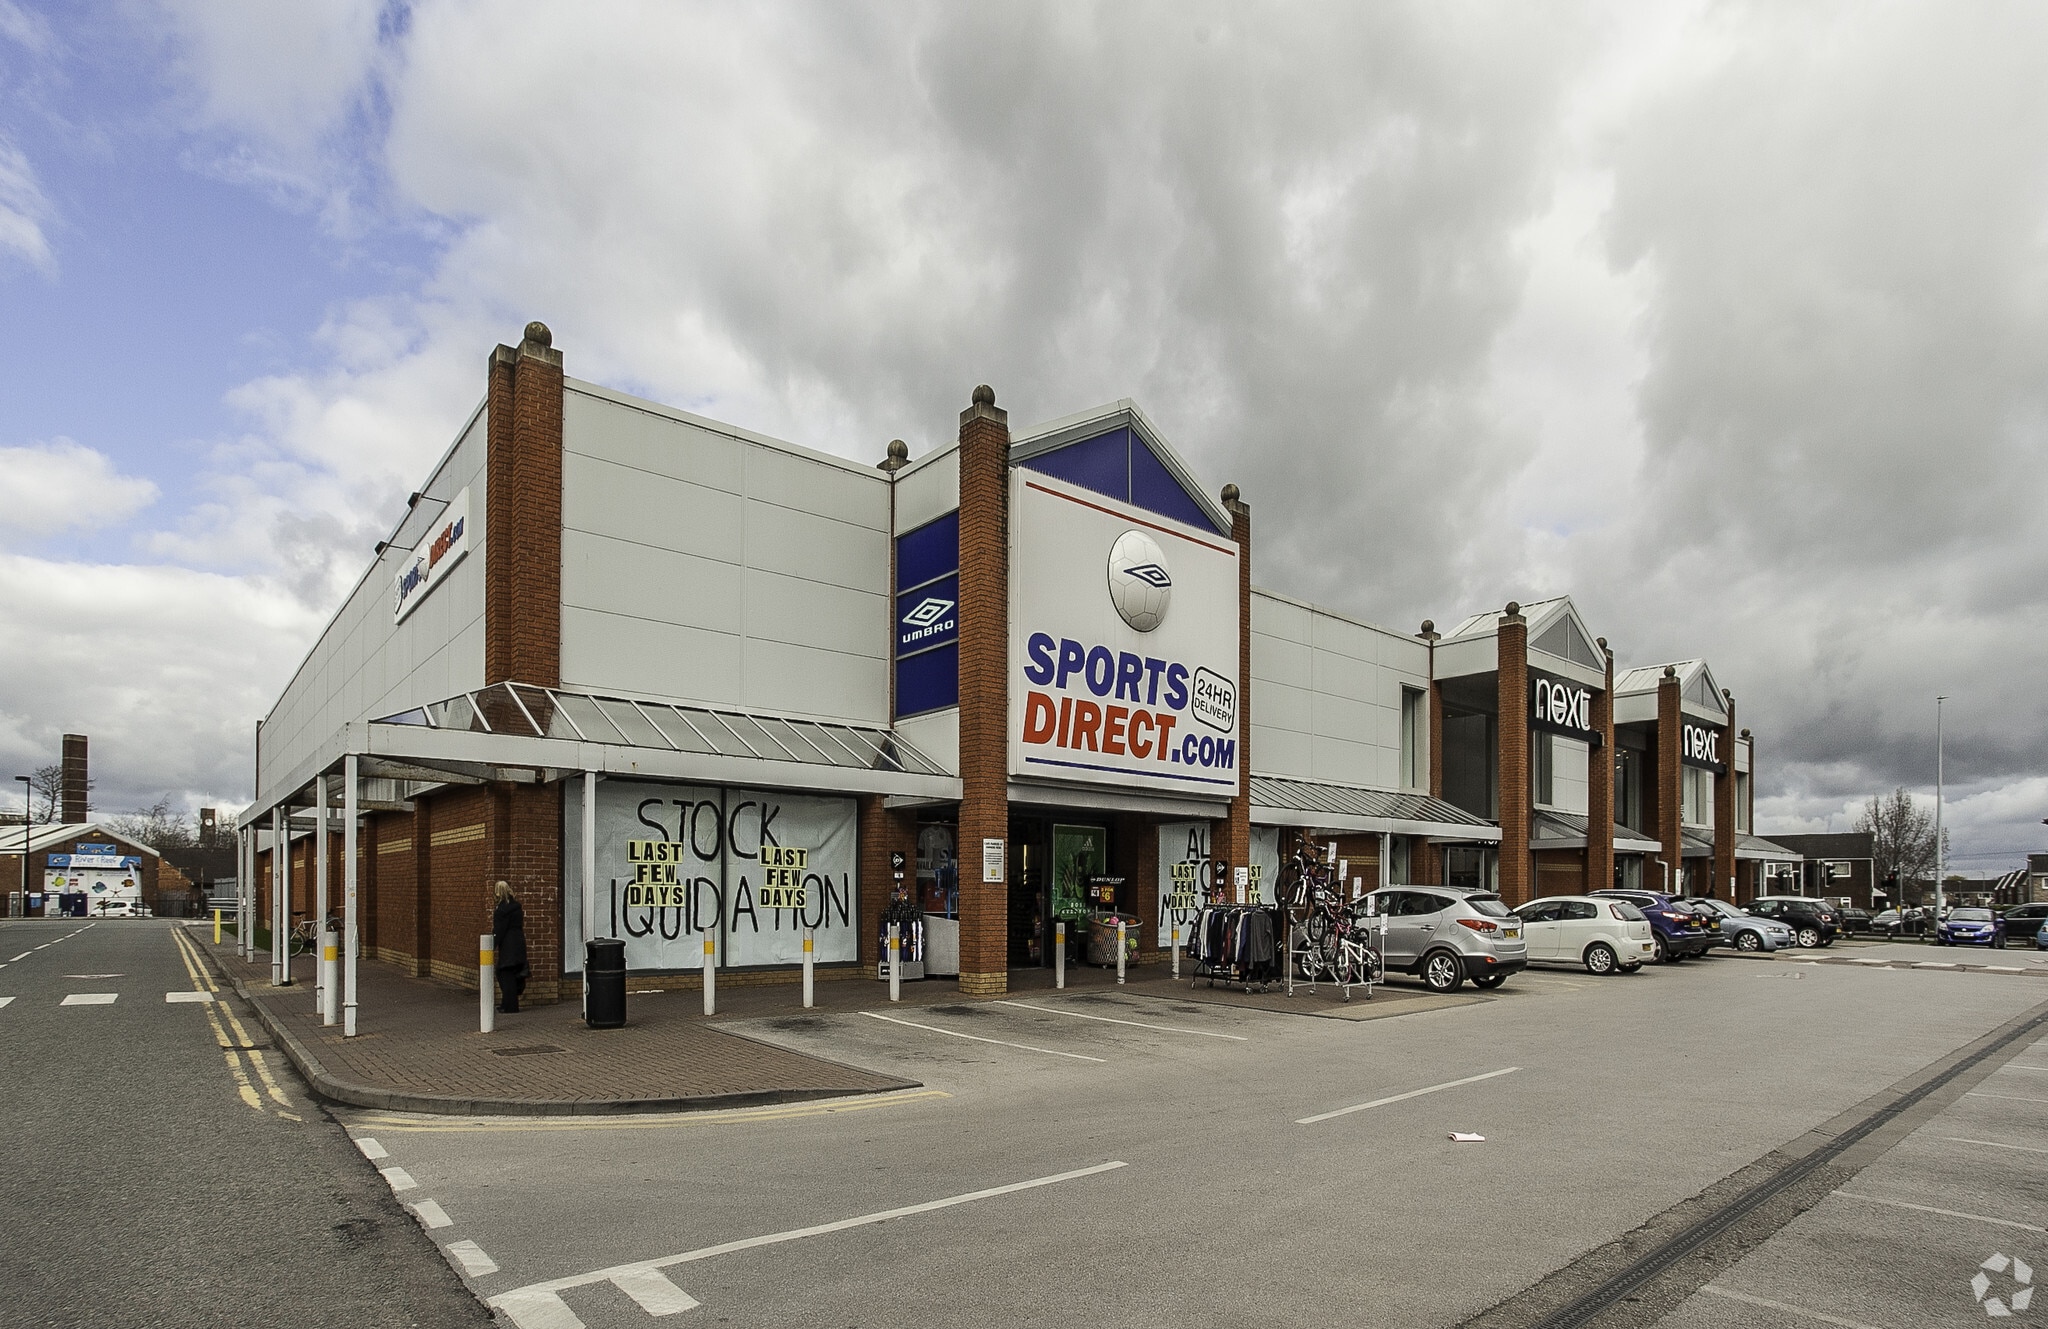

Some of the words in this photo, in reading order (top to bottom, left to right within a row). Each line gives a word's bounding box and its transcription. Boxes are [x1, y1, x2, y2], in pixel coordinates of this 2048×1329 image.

[902, 619, 954, 643] UMBRO
[1023, 632, 1190, 711] SPORTS
[1197, 678, 1232, 710] 24HR
[1194, 697, 1232, 724] DELIVERY
[1536, 679, 1591, 731] next
[1684, 724, 1720, 764] next
[638, 798, 780, 861] STOCK
[629, 841, 682, 861] LAST
[1186, 828, 1210, 859] AL
[761, 847, 807, 867] LAST
[636, 864, 676, 883] FEW
[766, 868, 801, 887] FEW
[1171, 865, 1196, 878] LAST
[1251, 866, 1261, 877] ST
[630, 886, 684, 905] DAYS
[760, 889, 806, 907] DAYS
[1171, 895, 1196, 908] DAYS
